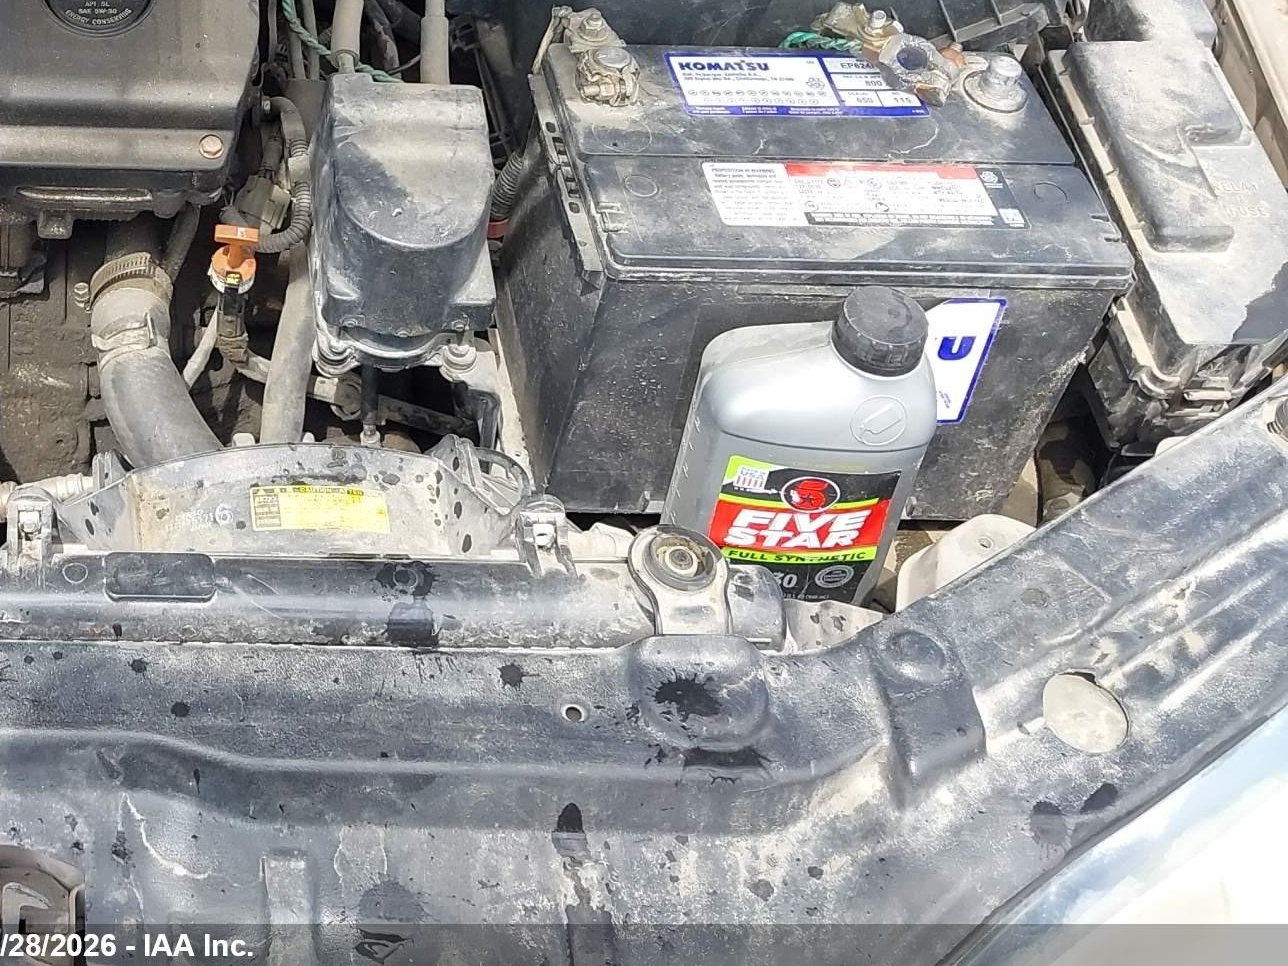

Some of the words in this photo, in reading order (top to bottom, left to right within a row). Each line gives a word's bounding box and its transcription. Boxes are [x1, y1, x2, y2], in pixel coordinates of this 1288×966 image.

[678, 60, 770, 72] KOMATSU
[732, 508, 872, 532] FIVE
[723, 527, 860, 549] STAR
[728, 549, 768, 561] FULL
